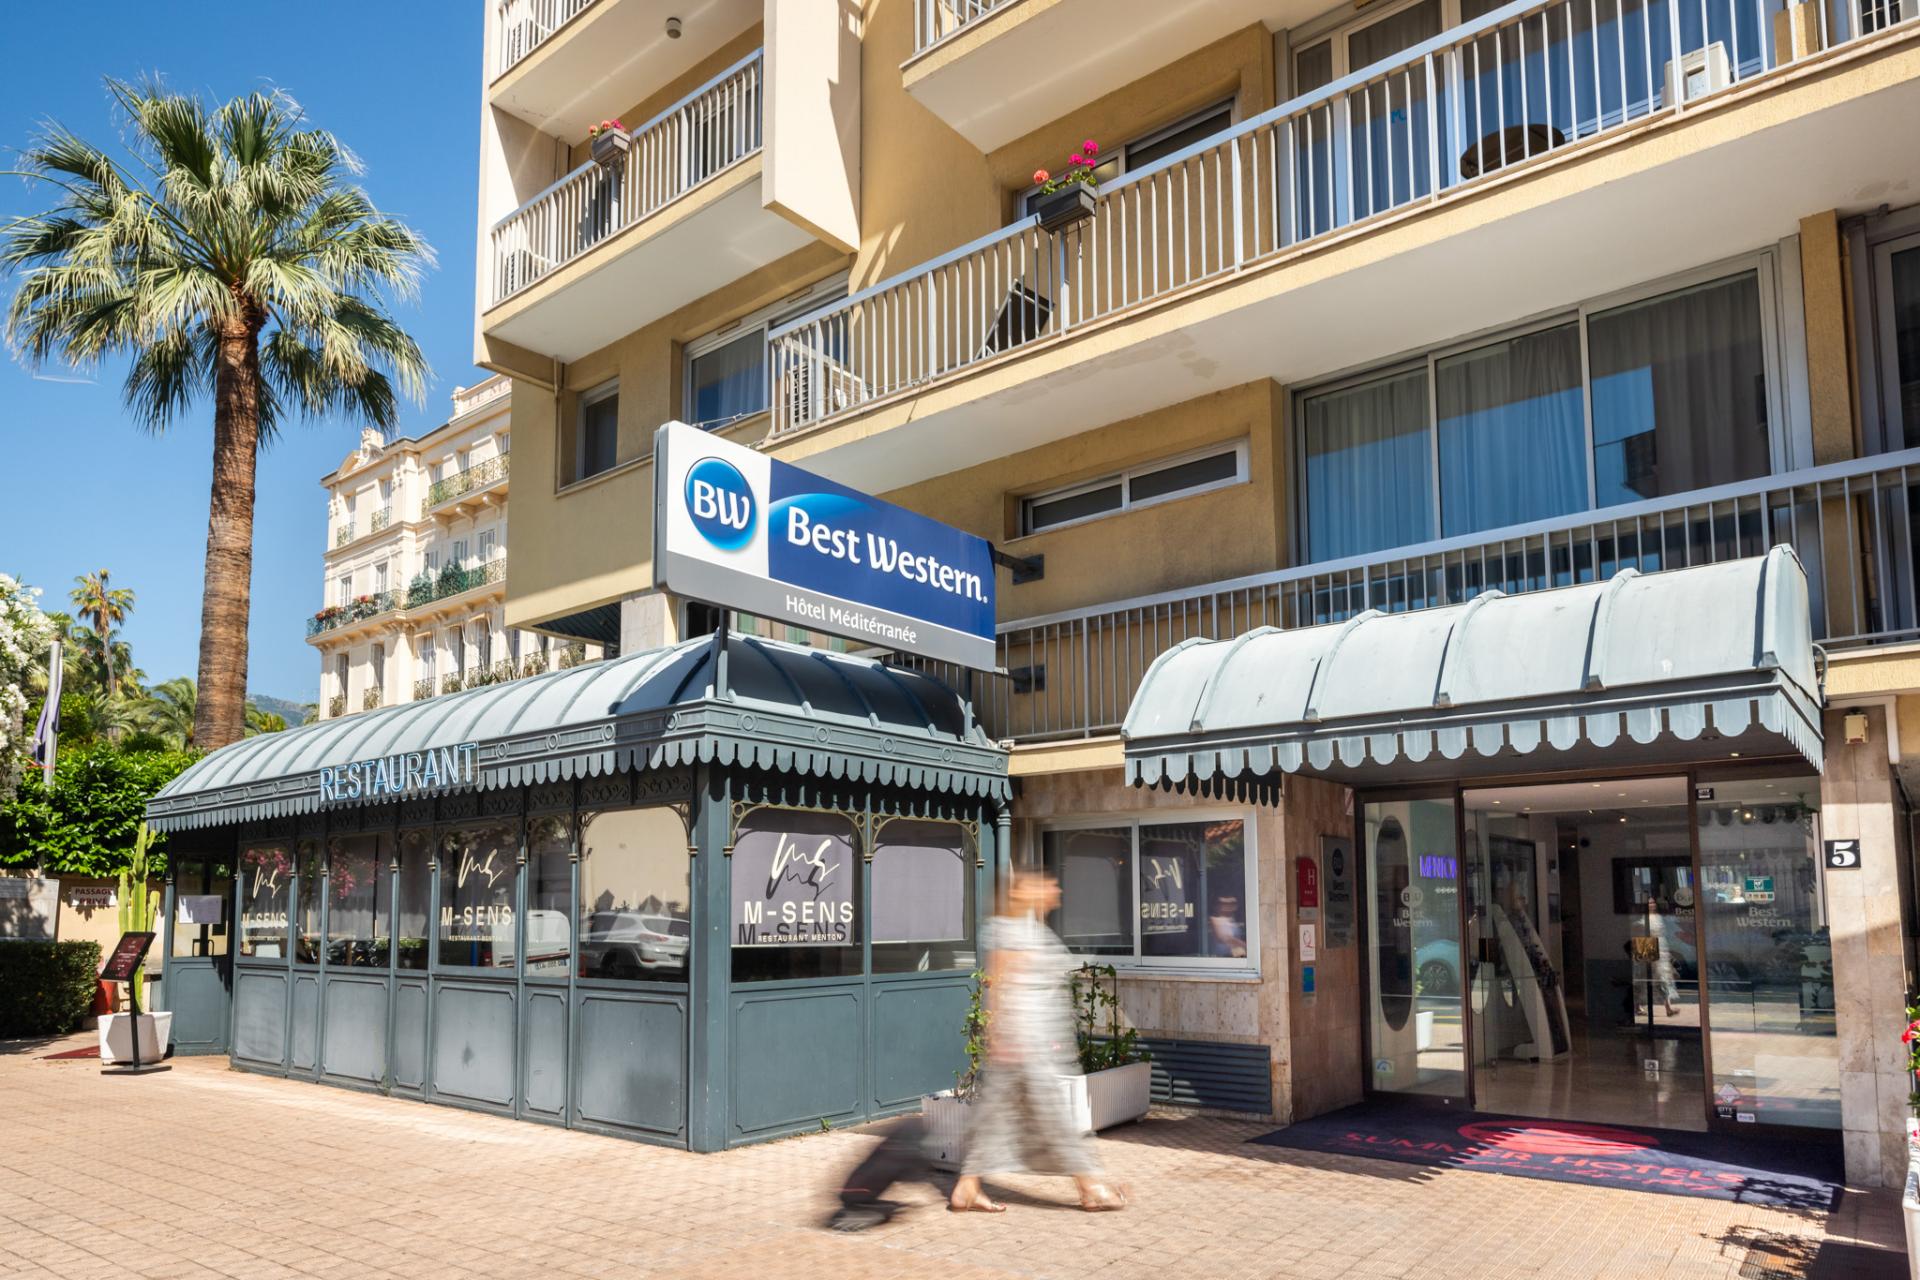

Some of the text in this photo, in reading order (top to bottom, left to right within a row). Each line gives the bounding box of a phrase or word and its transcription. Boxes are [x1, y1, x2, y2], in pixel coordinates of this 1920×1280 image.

[693, 479, 750, 531] BW
[787, 506, 861, 565] Best
[785, 594, 917, 644] Hôtel Méditérranée
[320, 742, 479, 801] RESTAURANT
[1831, 841, 1856, 867] 5
[1307, 868, 1316, 886] H
[75, 887, 113, 895] PASSAGE
[441, 905, 512, 927] M-SENS
[743, 900, 853, 924] M-SENS
[1749, 906, 1778, 918] Best
[757, 933, 843, 943] RESTAURANT MENTON
[1551, 1156, 1745, 1183] HOTELS
